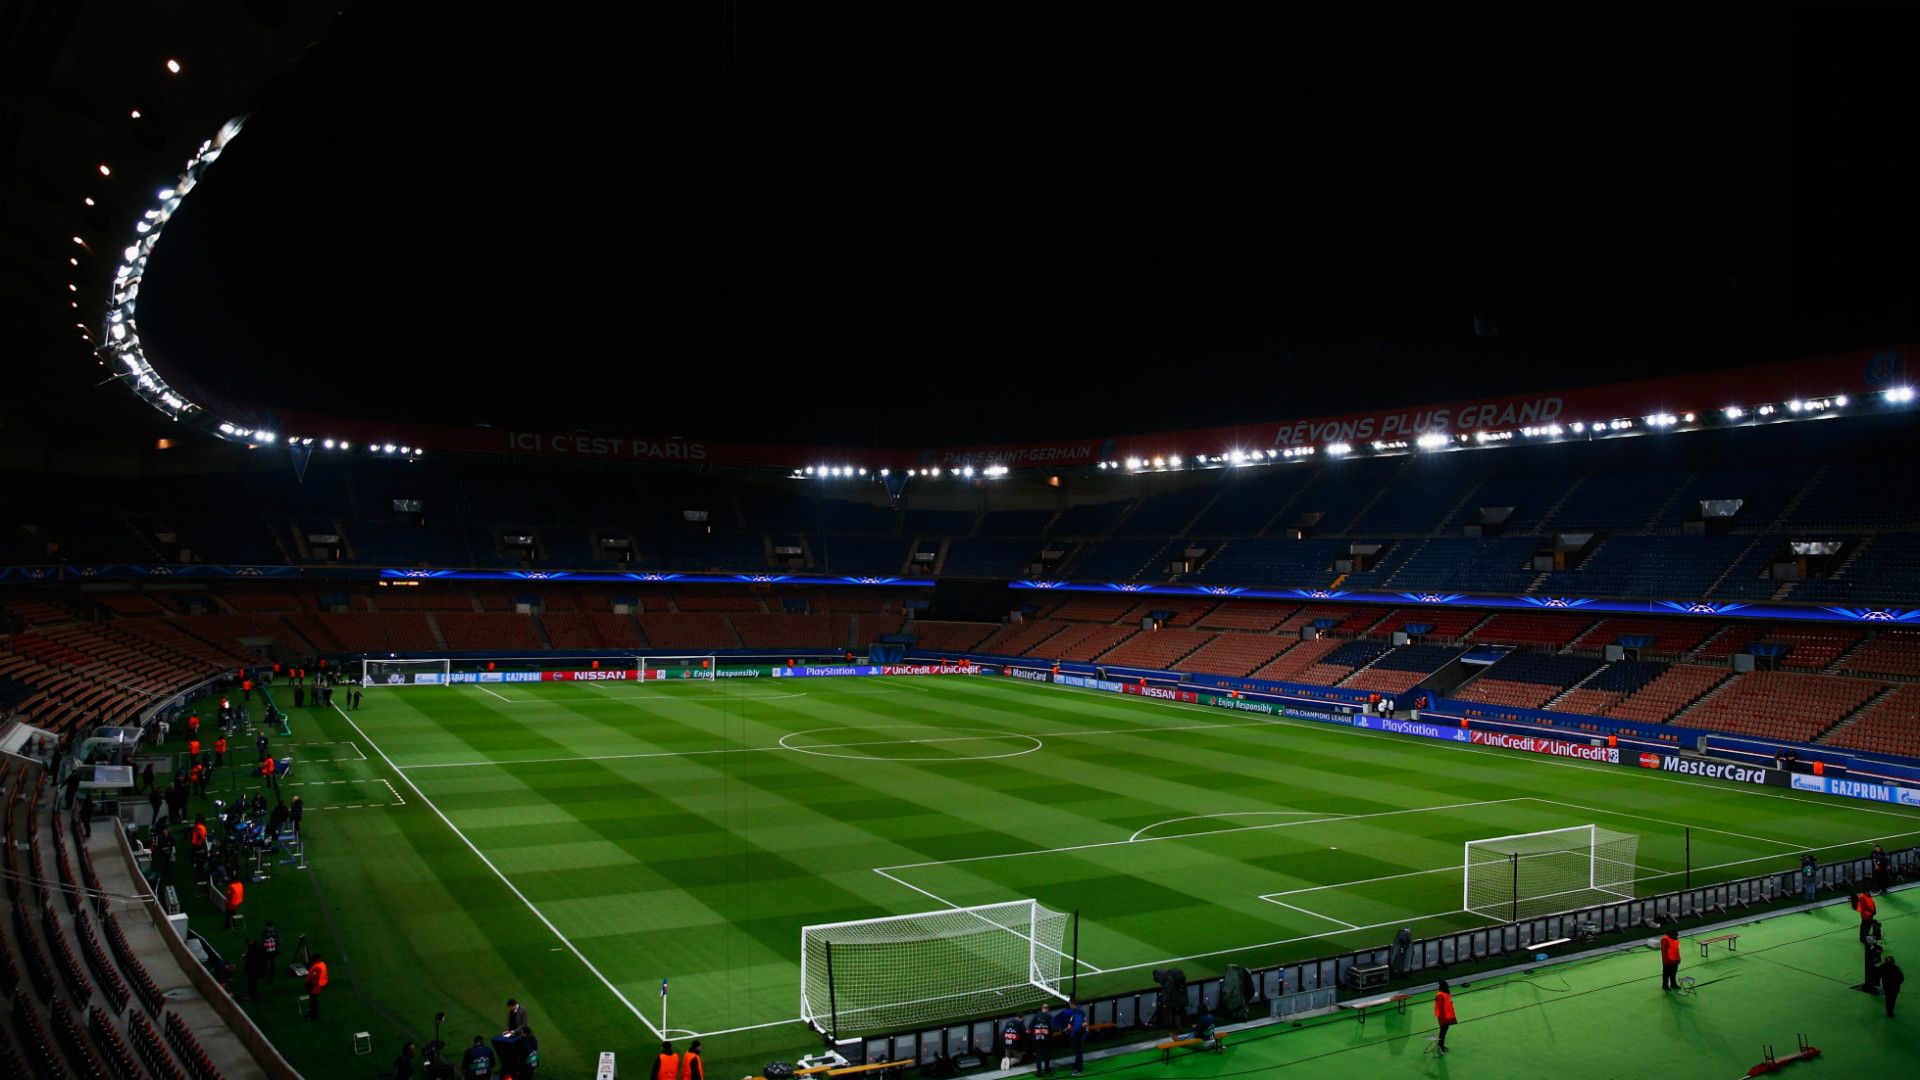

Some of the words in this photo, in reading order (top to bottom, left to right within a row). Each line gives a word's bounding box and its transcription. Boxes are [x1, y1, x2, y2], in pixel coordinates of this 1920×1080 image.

[1275, 418, 1375, 445] RÊVONS
[1380, 409, 1449, 435] PLUS
[1457, 397, 1563, 428] GRAND
[509, 432, 541, 449] ICI
[551, 435, 623, 455] C'EST
[632, 440, 706, 459] PARIS
[942, 451, 983, 464] PARIS
[986, 446, 1092, 463] SAINT-GERMAIN
[574, 671, 626, 680] NISSAN
[716, 669, 760, 678] Responsibly
[806, 666, 856, 676] PlayStation
[892, 665, 930, 675] UniCredit
[940, 665, 979, 674] UniCredit
[1012, 668, 1047, 682] MasterCard
[1141, 686, 1176, 700] NISSAN
[1218, 697, 1235, 709] Enjoy
[1236, 700, 1272, 714] Responsibly
[1286, 708, 1299, 717] UEFA
[1300, 710, 1330, 721] CHAMPIONS
[1331, 714, 1353, 723] LEAGUE
[1382, 719, 1439, 737] PlayStation
[1484, 733, 1535, 751] UniCredit
[1551, 743, 1607, 762] UniCredit
[1663, 755, 1766, 784] MasterCard
[1831, 779, 1889, 801] GAZPROM
